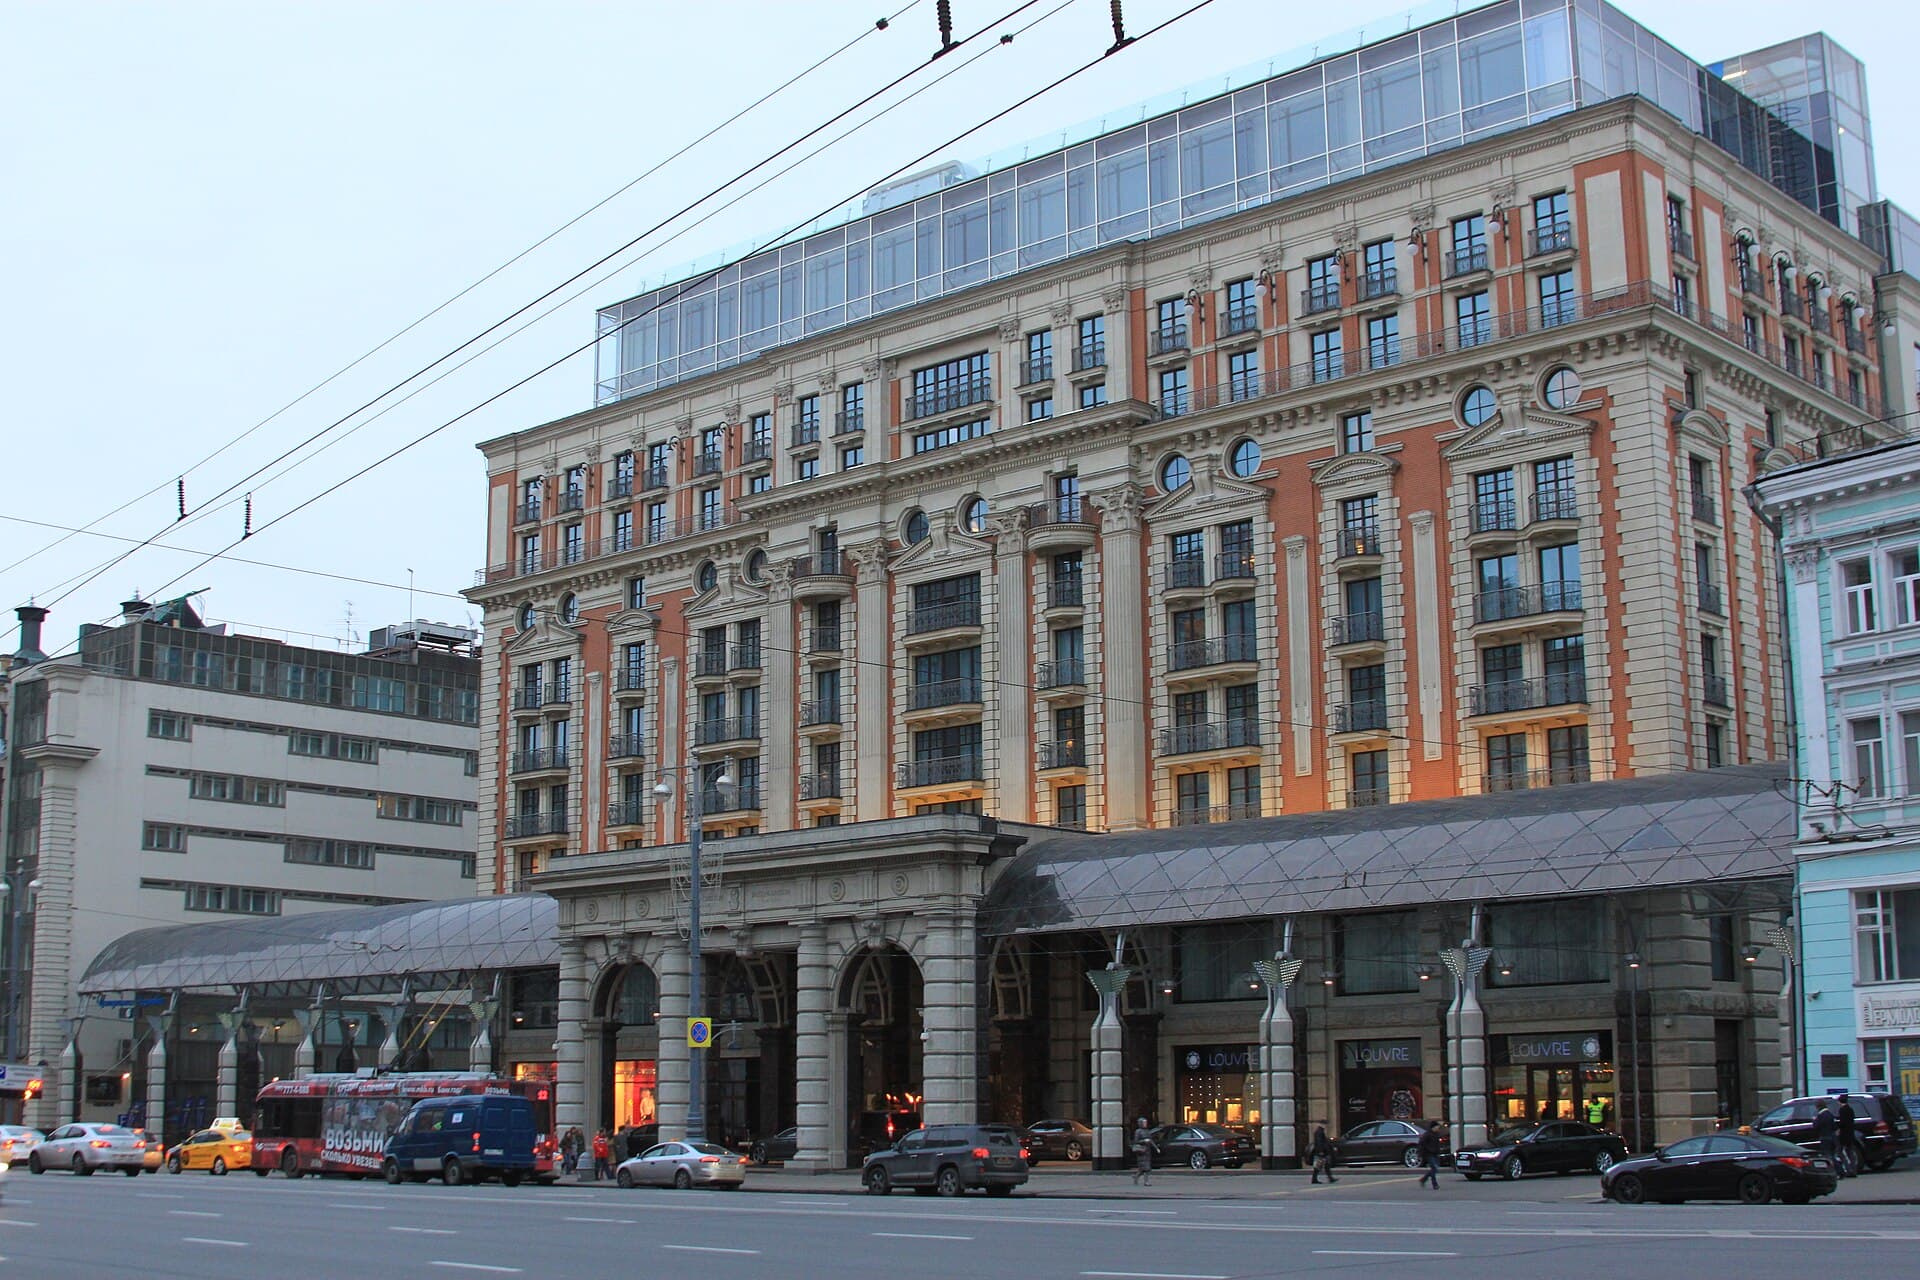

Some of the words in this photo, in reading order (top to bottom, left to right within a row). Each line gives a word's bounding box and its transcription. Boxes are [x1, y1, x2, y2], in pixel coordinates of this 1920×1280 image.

[1355, 1047, 1409, 1062] LOUVRE
[1512, 1041, 1572, 1057] LOUVRE
[1208, 1052, 1259, 1066] LOUVRE
[325, 1128, 385, 1153] ВОЗЬМИ
[321, 1149, 351, 1165] СКОЛЬКО
